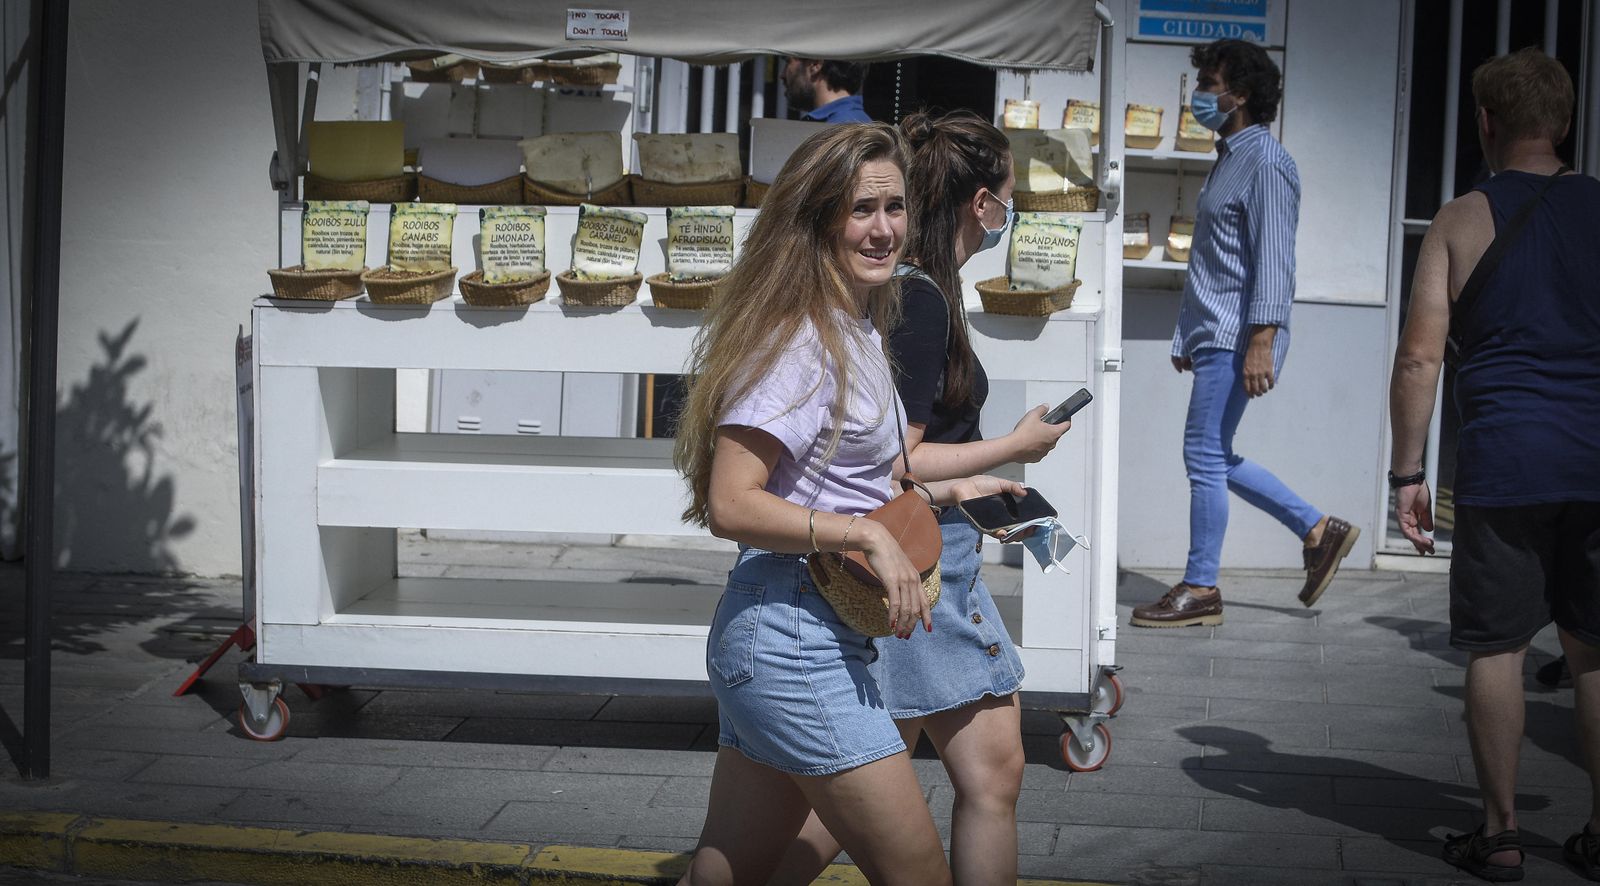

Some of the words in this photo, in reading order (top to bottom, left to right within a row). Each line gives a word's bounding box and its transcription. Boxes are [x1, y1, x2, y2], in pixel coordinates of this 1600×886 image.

[595, 12, 625, 22] TOCAR!
[573, 27, 595, 35] DON'T
[601, 28, 628, 41] TOUCH!
[1163, 20, 1242, 39] CIUDAD
[305, 217, 341, 227] ROOIBOS
[344, 218, 366, 227] ZULU
[402, 221, 440, 230] ROOIBOS
[496, 223, 531, 232] ROOIBOS
[579, 220, 608, 232] ROOIBOS
[610, 224, 640, 238] BANANA
[680, 222, 691, 234] TÉ
[694, 222, 722, 234] HINDÚ
[402, 233, 439, 242] CANABIS
[491, 234, 536, 242] LIMONADA
[589, 230, 628, 244] CARAMELO
[672, 236, 731, 244] AFRODISIACO
[1016, 233, 1076, 248] ARÁNDANOS
